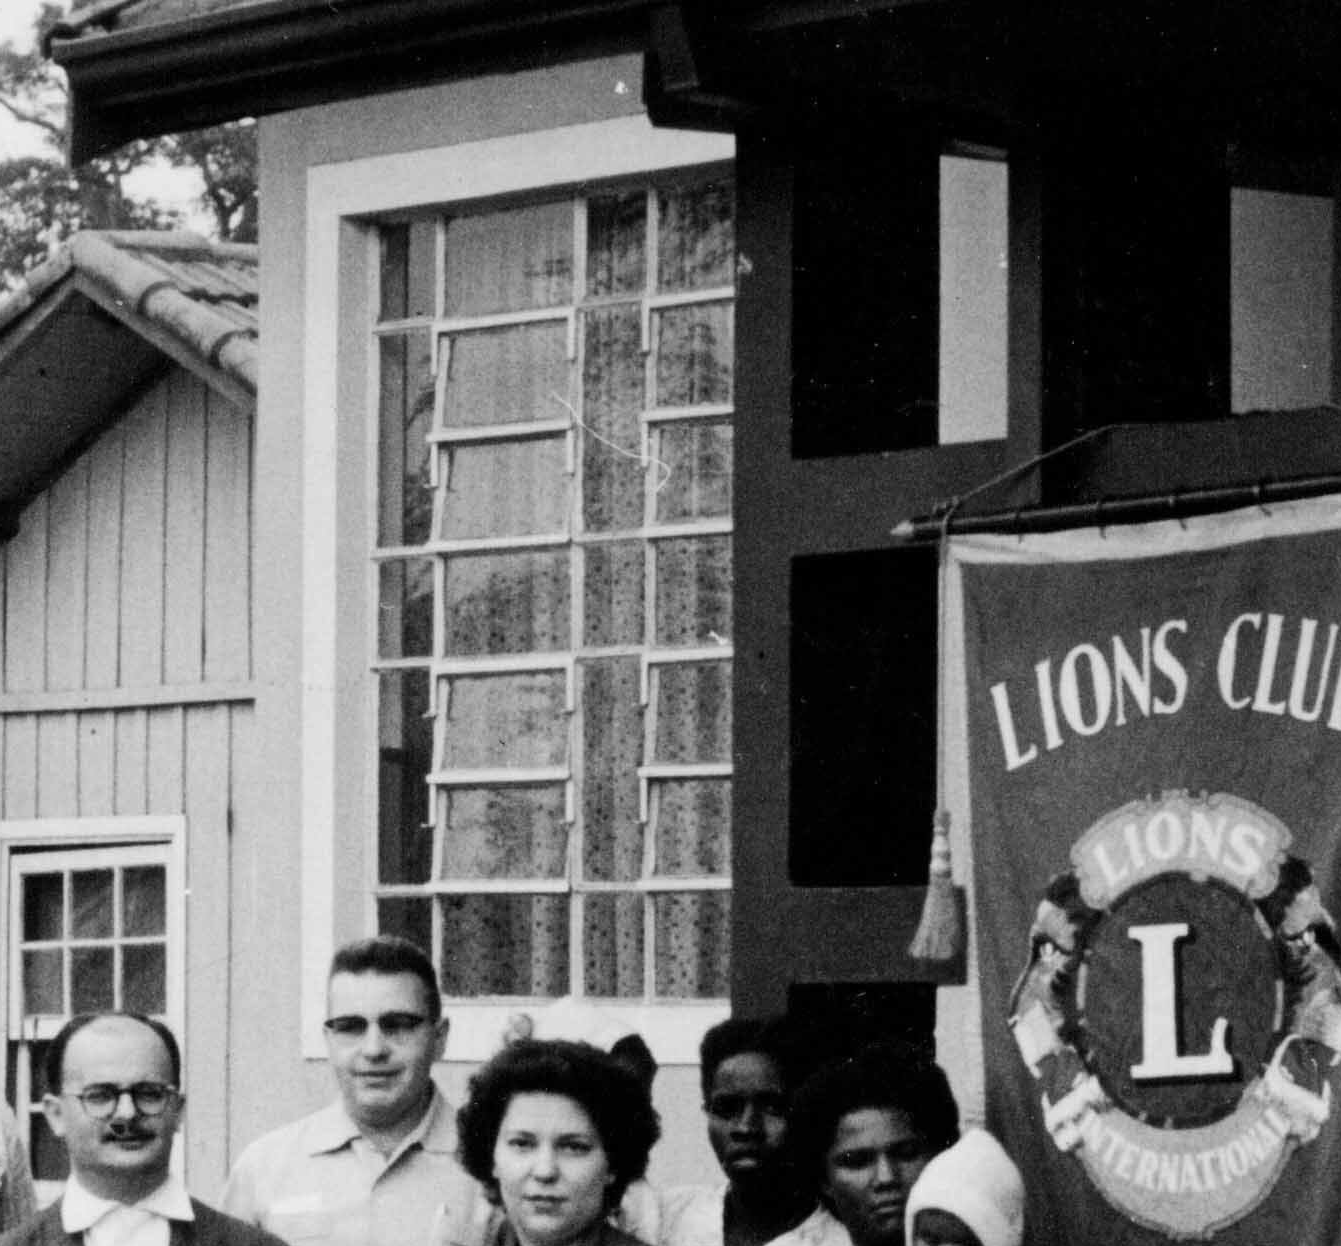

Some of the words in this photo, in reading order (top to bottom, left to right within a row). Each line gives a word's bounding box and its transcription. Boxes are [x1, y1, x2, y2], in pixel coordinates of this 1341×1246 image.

[989, 619, 1188, 771] LIONS
[1093, 810, 1267, 884] LIONS
[1128, 922, 1234, 1079] L
